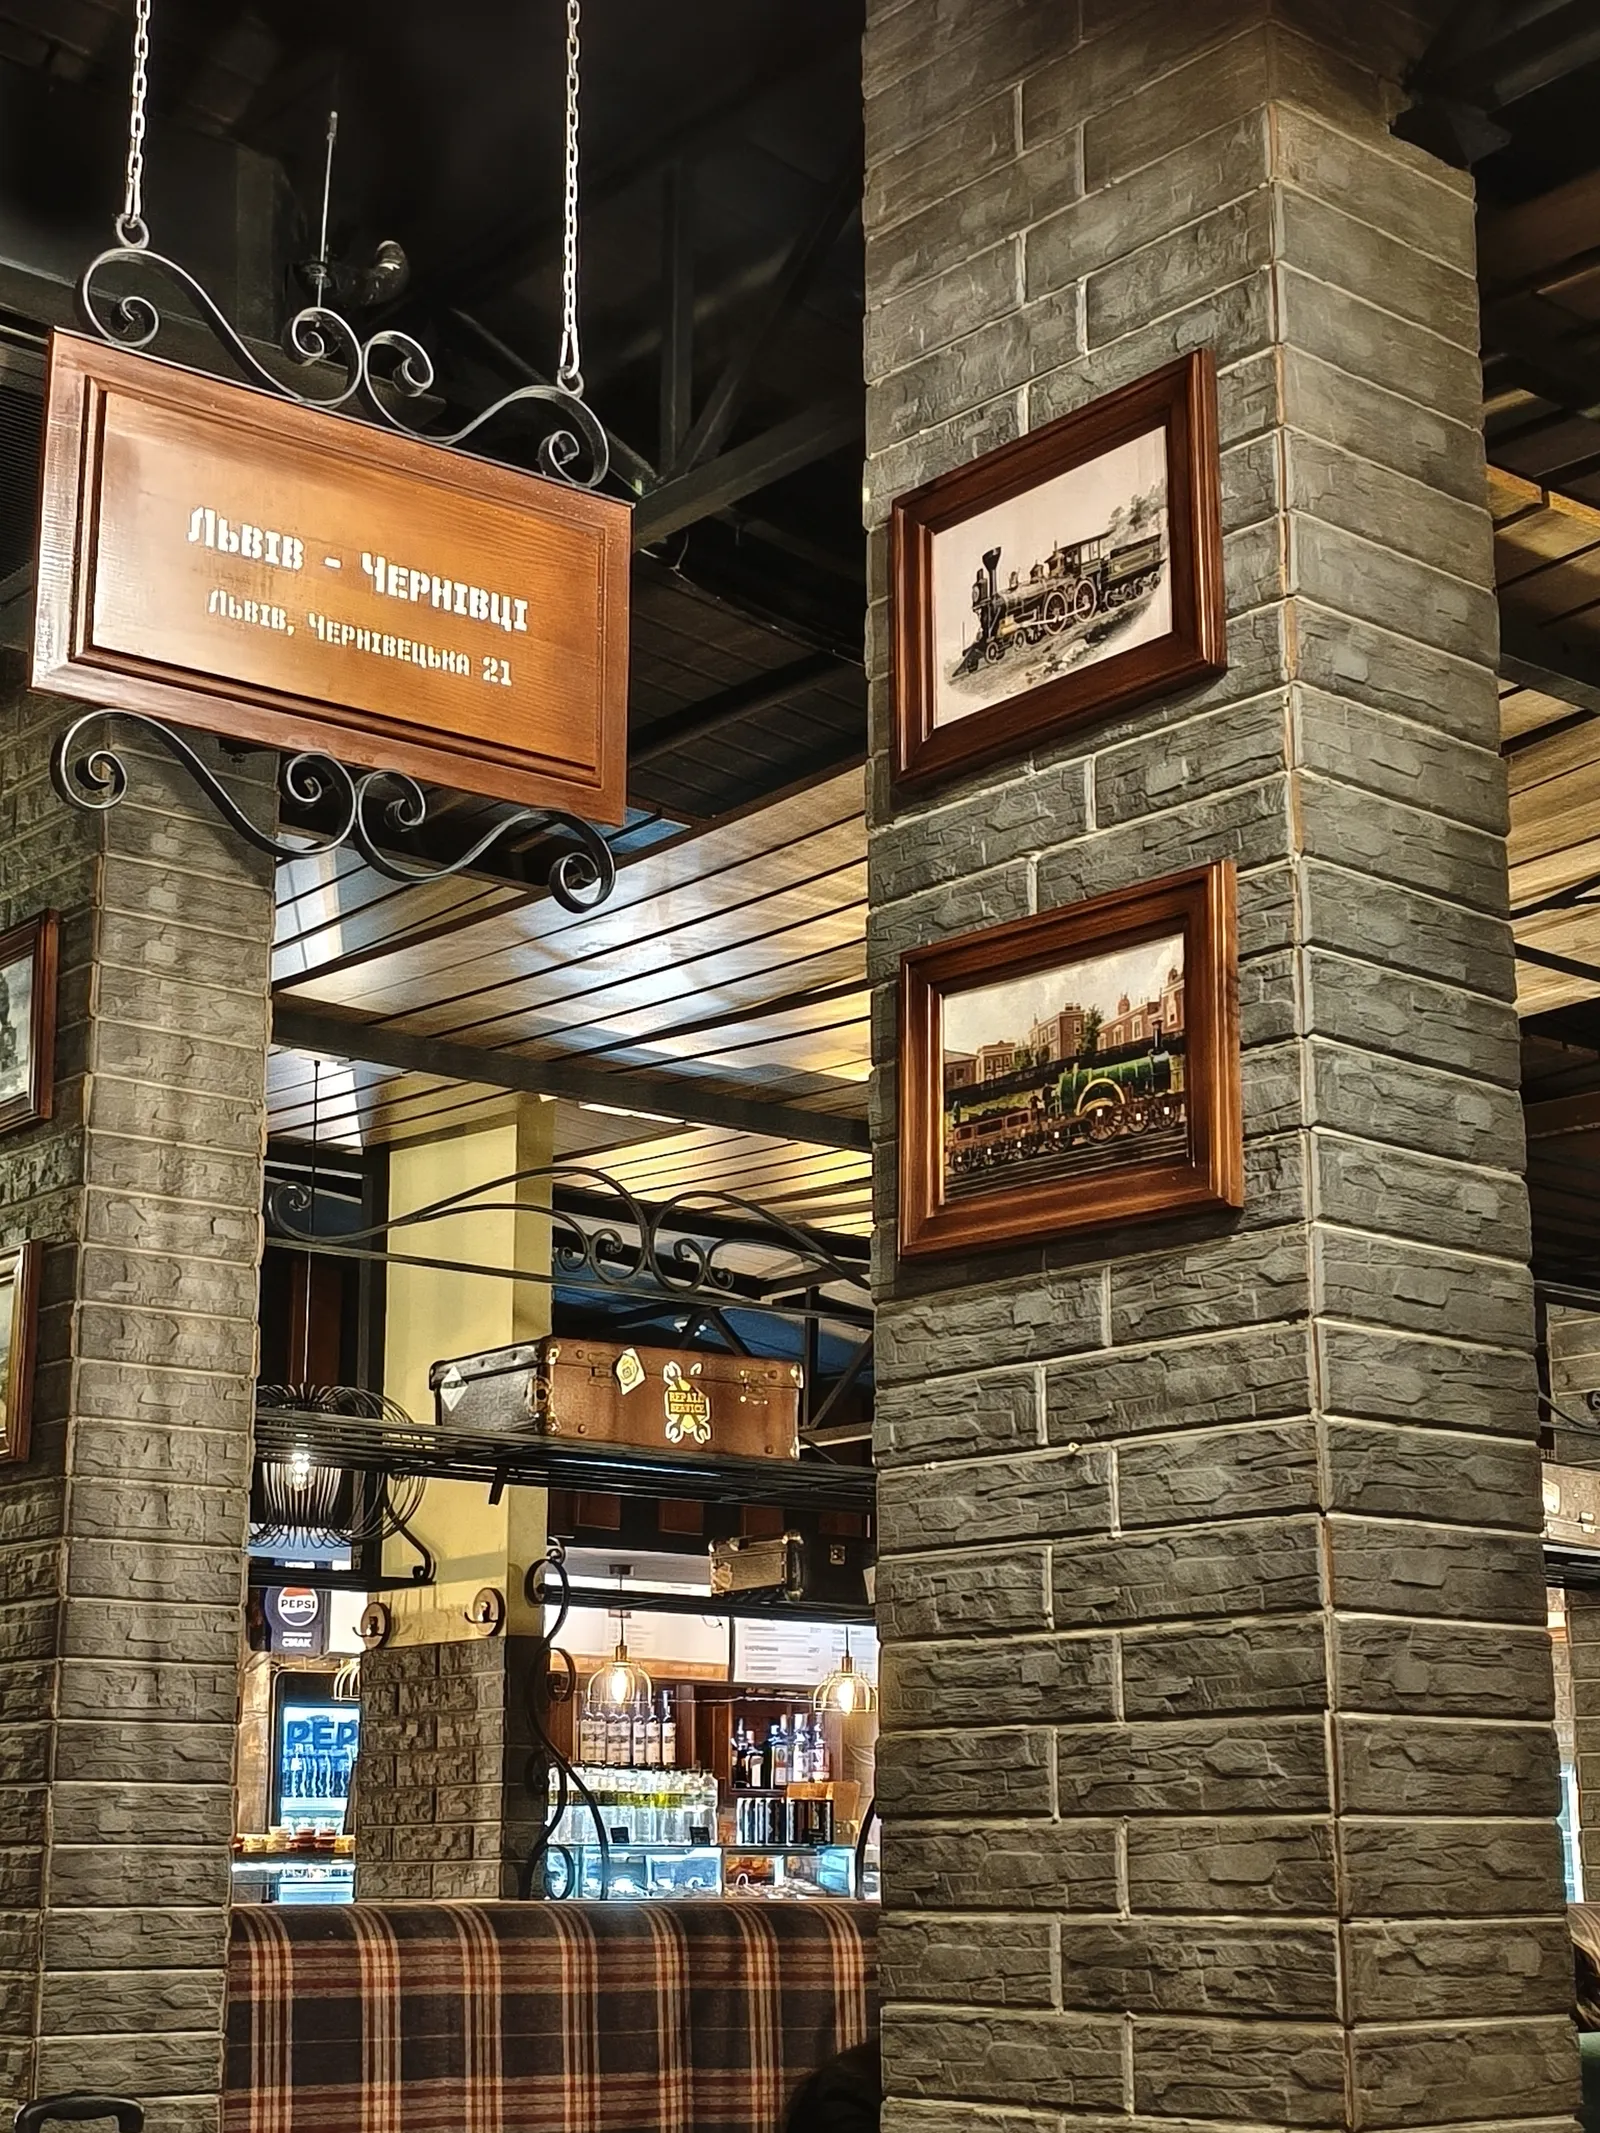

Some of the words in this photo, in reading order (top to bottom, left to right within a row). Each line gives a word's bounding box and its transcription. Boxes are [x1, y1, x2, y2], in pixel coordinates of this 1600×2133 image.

[187, 506, 305, 571] ЛЬВІВ
[361, 552, 530, 632] ЧЕРНІВЦІ
[208, 589, 295, 636] ЛЬВІВ,
[308, 612, 471, 677] ЧЕРНІВЕЦЬКА
[482, 656, 513, 686] 21
[281, 1599, 315, 1609] PEPSI
